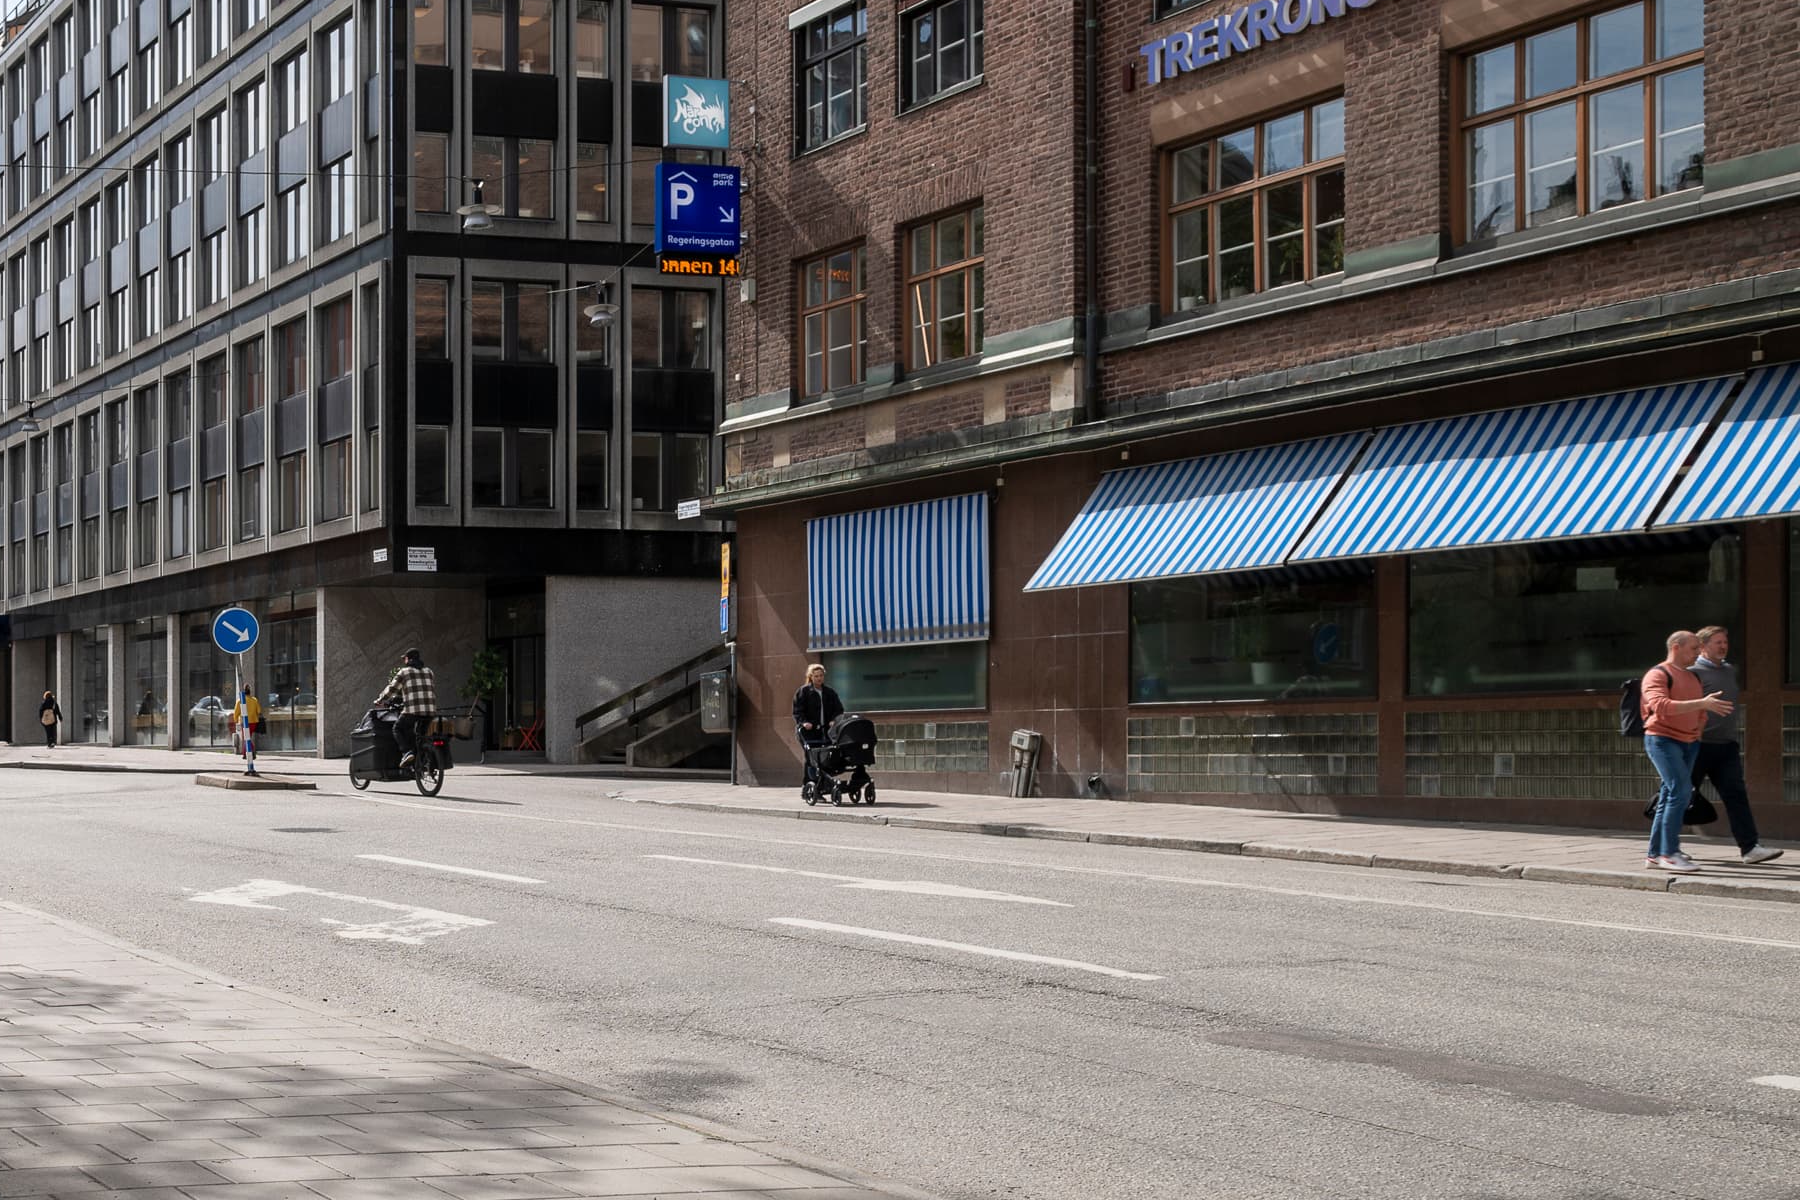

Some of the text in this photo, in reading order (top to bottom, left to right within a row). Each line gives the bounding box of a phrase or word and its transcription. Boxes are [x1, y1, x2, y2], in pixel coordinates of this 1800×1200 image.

[713, 178, 734, 187] park
[670, 183, 695, 220] P
[667, 234, 735, 248] Regeringsgatan
[718, 258, 740, 277] 14
